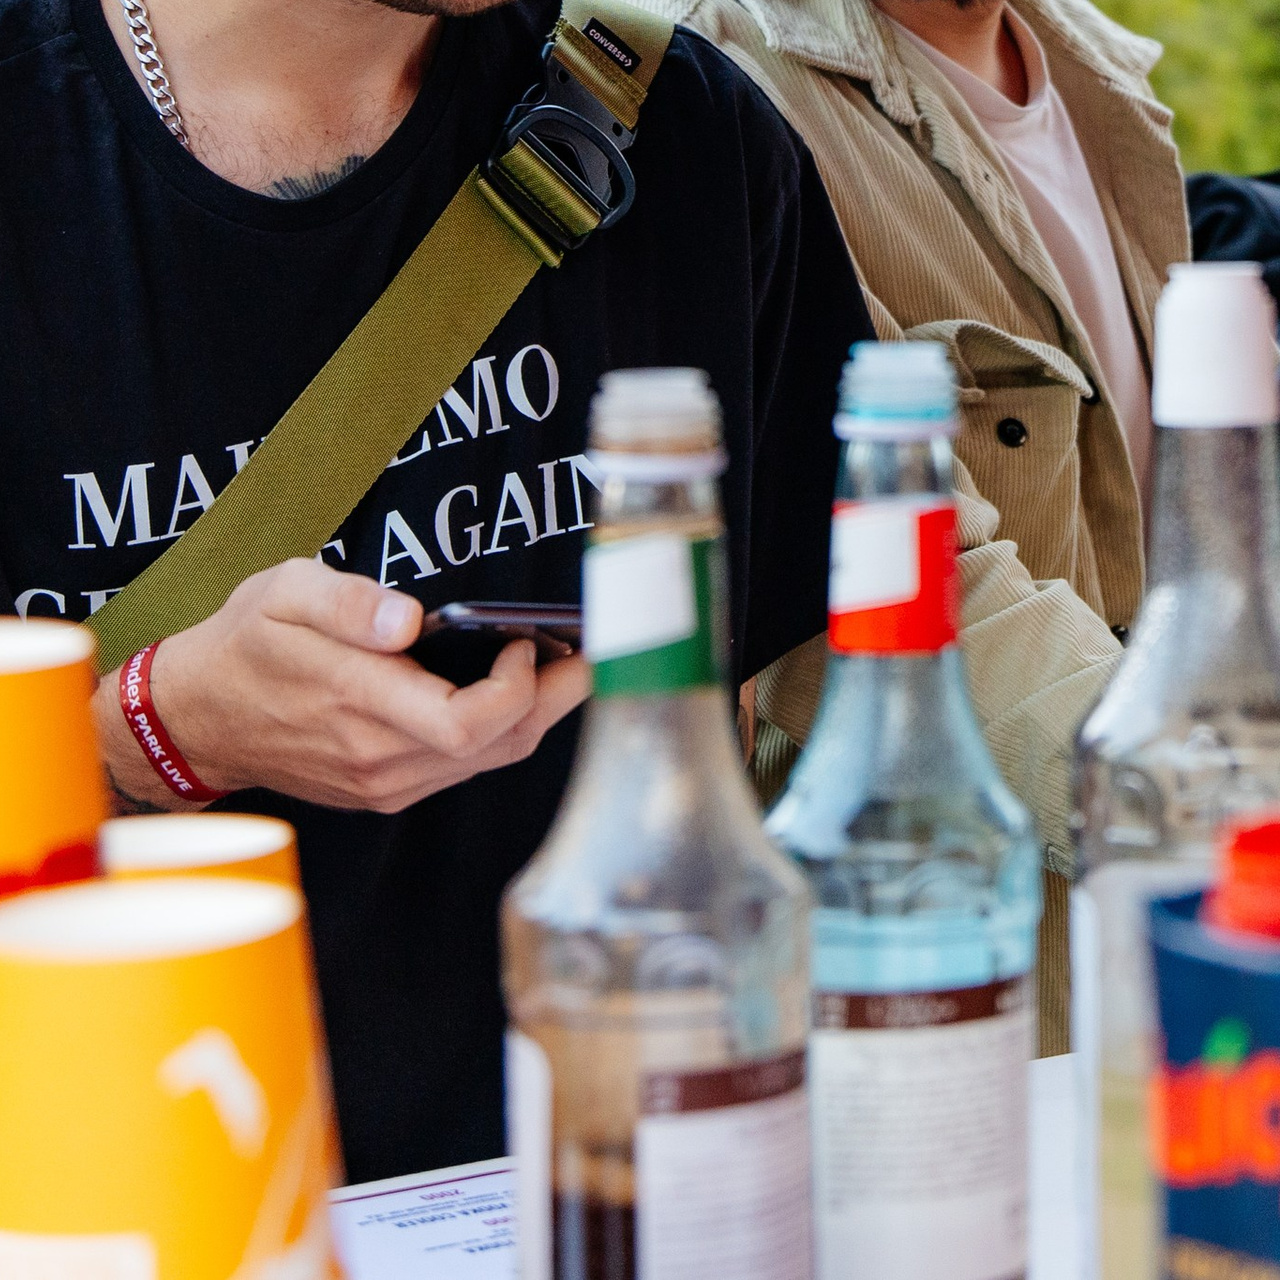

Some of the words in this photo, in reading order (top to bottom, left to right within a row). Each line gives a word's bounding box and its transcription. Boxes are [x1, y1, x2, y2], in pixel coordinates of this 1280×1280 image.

[589, 29, 626, 62] CONVERSE
[63, 436, 266, 549] MA
[134, 713, 166, 759] PARK
[161, 760, 193, 792] LIVE
